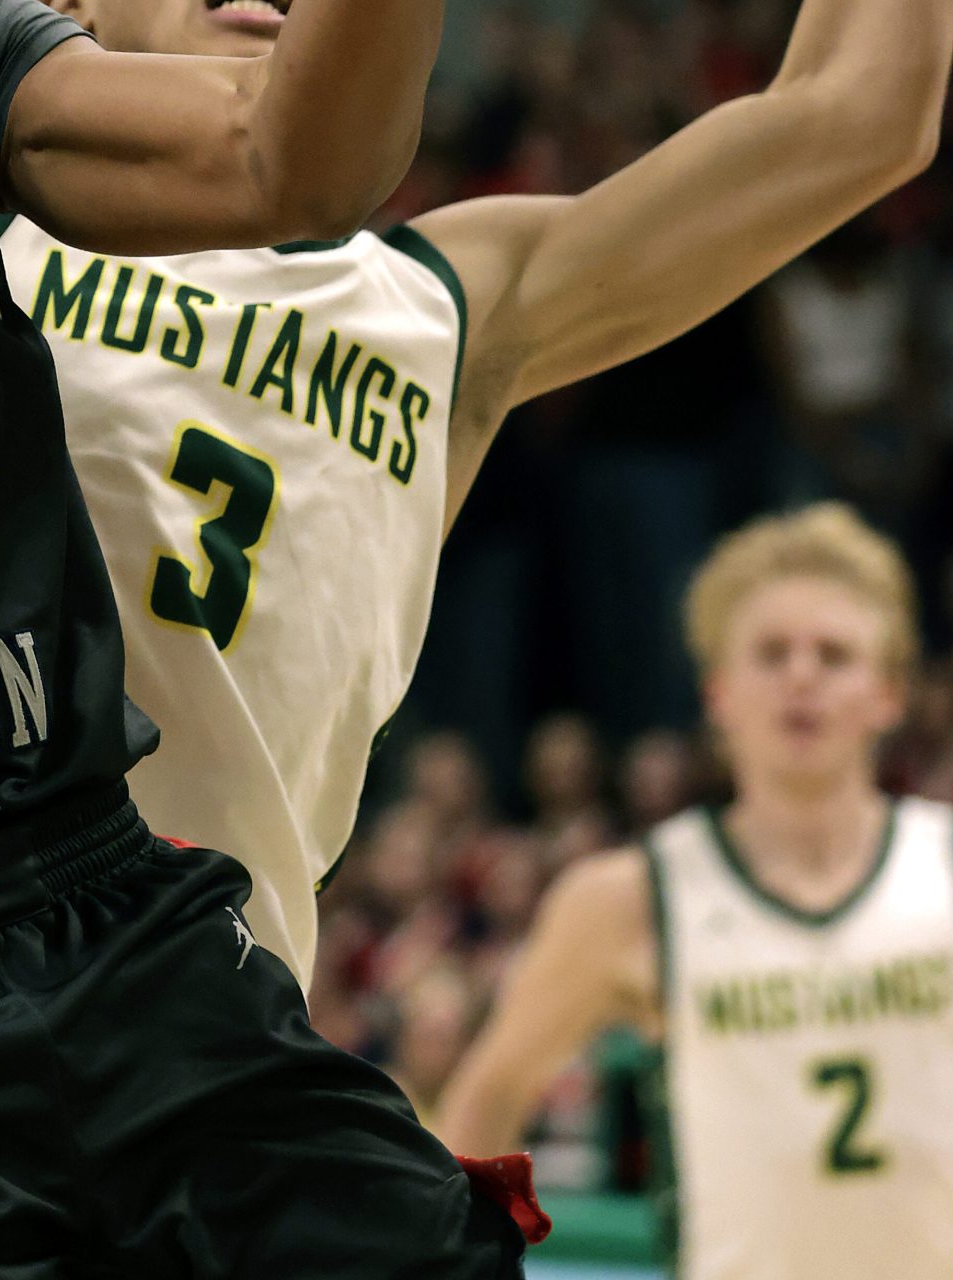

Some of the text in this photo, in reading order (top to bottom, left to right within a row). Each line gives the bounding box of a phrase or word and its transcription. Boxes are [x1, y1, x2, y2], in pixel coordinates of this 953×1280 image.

[30, 248, 432, 488] MUSTANGS
[145, 418, 281, 657] 3
[809, 1056, 888, 1178] 2
